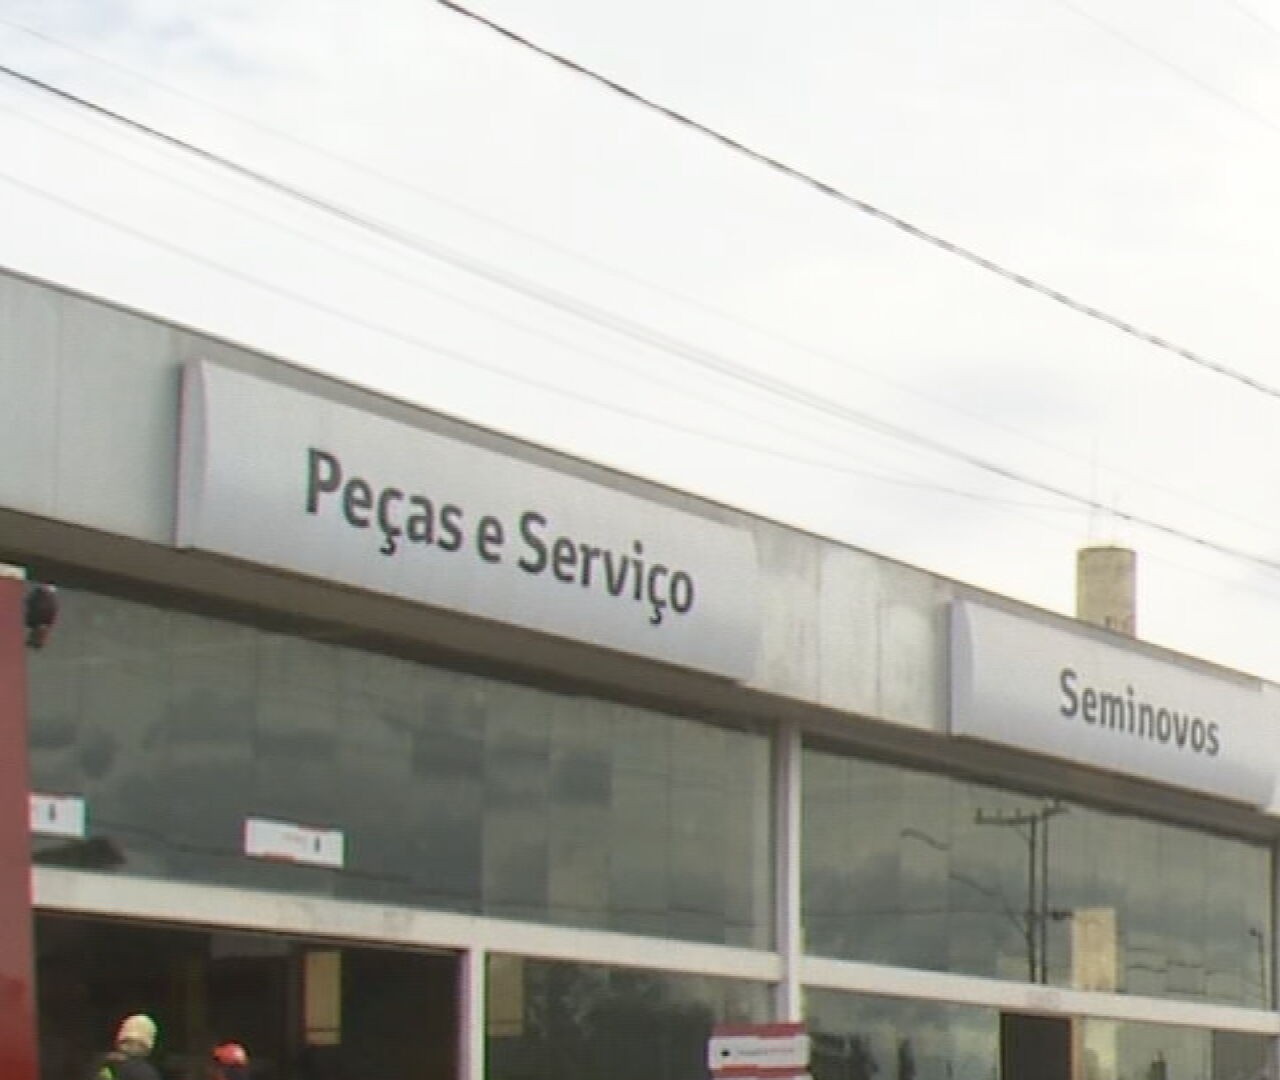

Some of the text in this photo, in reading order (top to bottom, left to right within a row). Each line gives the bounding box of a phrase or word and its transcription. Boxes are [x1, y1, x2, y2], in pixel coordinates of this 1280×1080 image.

[306, 447, 695, 625] Peças e Serviço
[1060, 667, 1220, 757] Seminovos
